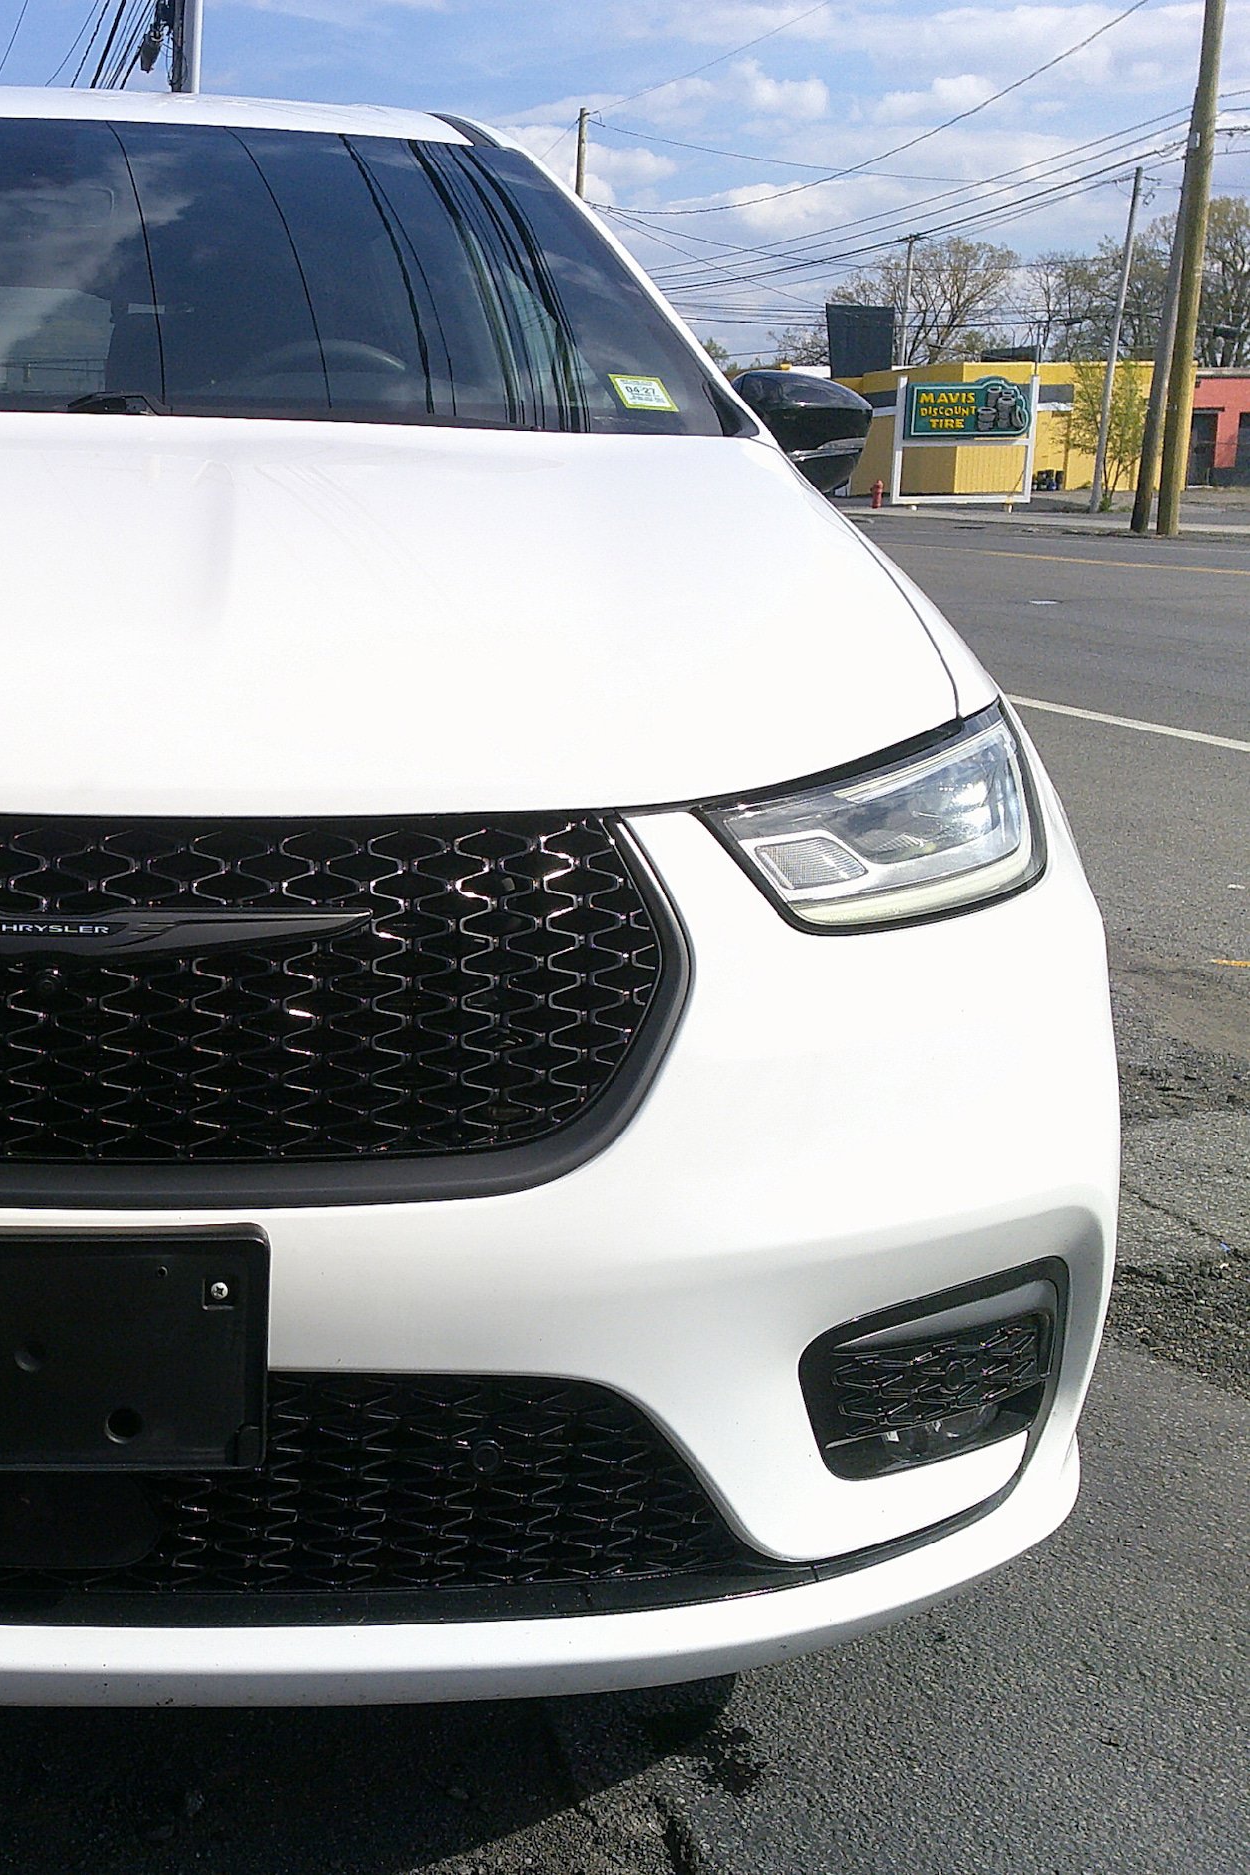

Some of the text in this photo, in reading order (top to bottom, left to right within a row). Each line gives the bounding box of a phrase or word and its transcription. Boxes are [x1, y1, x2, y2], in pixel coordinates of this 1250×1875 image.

[919, 392, 976, 405] MAVIS
[920, 405, 977, 417] DISCOUNT
[930, 418, 965, 430] TIRE
